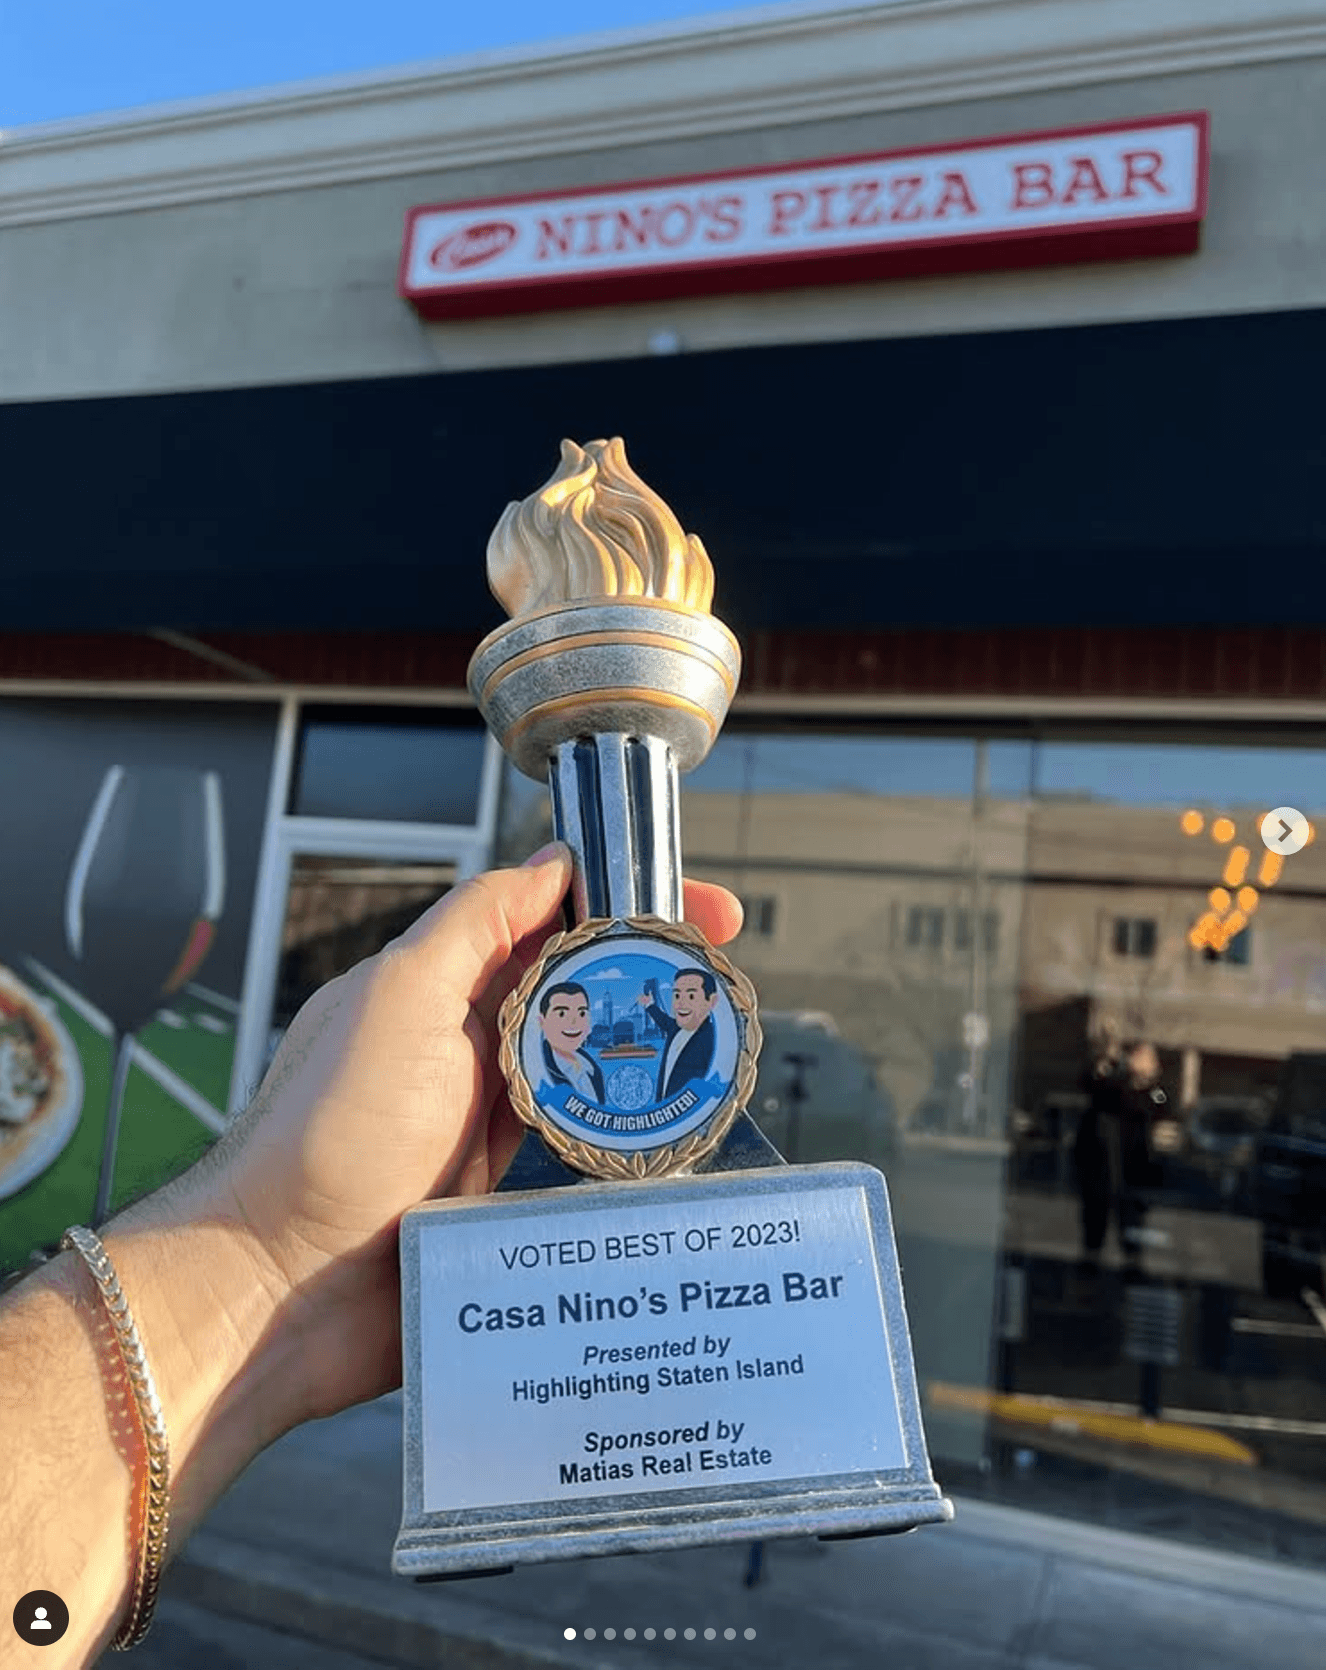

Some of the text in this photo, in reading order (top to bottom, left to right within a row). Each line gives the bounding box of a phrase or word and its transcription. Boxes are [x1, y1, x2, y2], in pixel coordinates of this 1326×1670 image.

[534, 198, 742, 262] NINO'S
[770, 171, 979, 237] PIZZA
[1010, 150, 1167, 210] BAR
[564, 1091, 698, 1131] WE GOT HIGHLIGHTED!
[499, 1219, 801, 1270] VOTED BEST OF 2023!
[457, 1302, 546, 1334] Casa
[680, 1279, 772, 1313] Pizza
[783, 1271, 843, 1303] Bar
[583, 1335, 731, 1365] Presented by
[512, 1354, 804, 1404] Highlighting Staten Island
[584, 1419, 745, 1454] Sponsored by
[559, 1446, 772, 1485] Matias Real Estate
